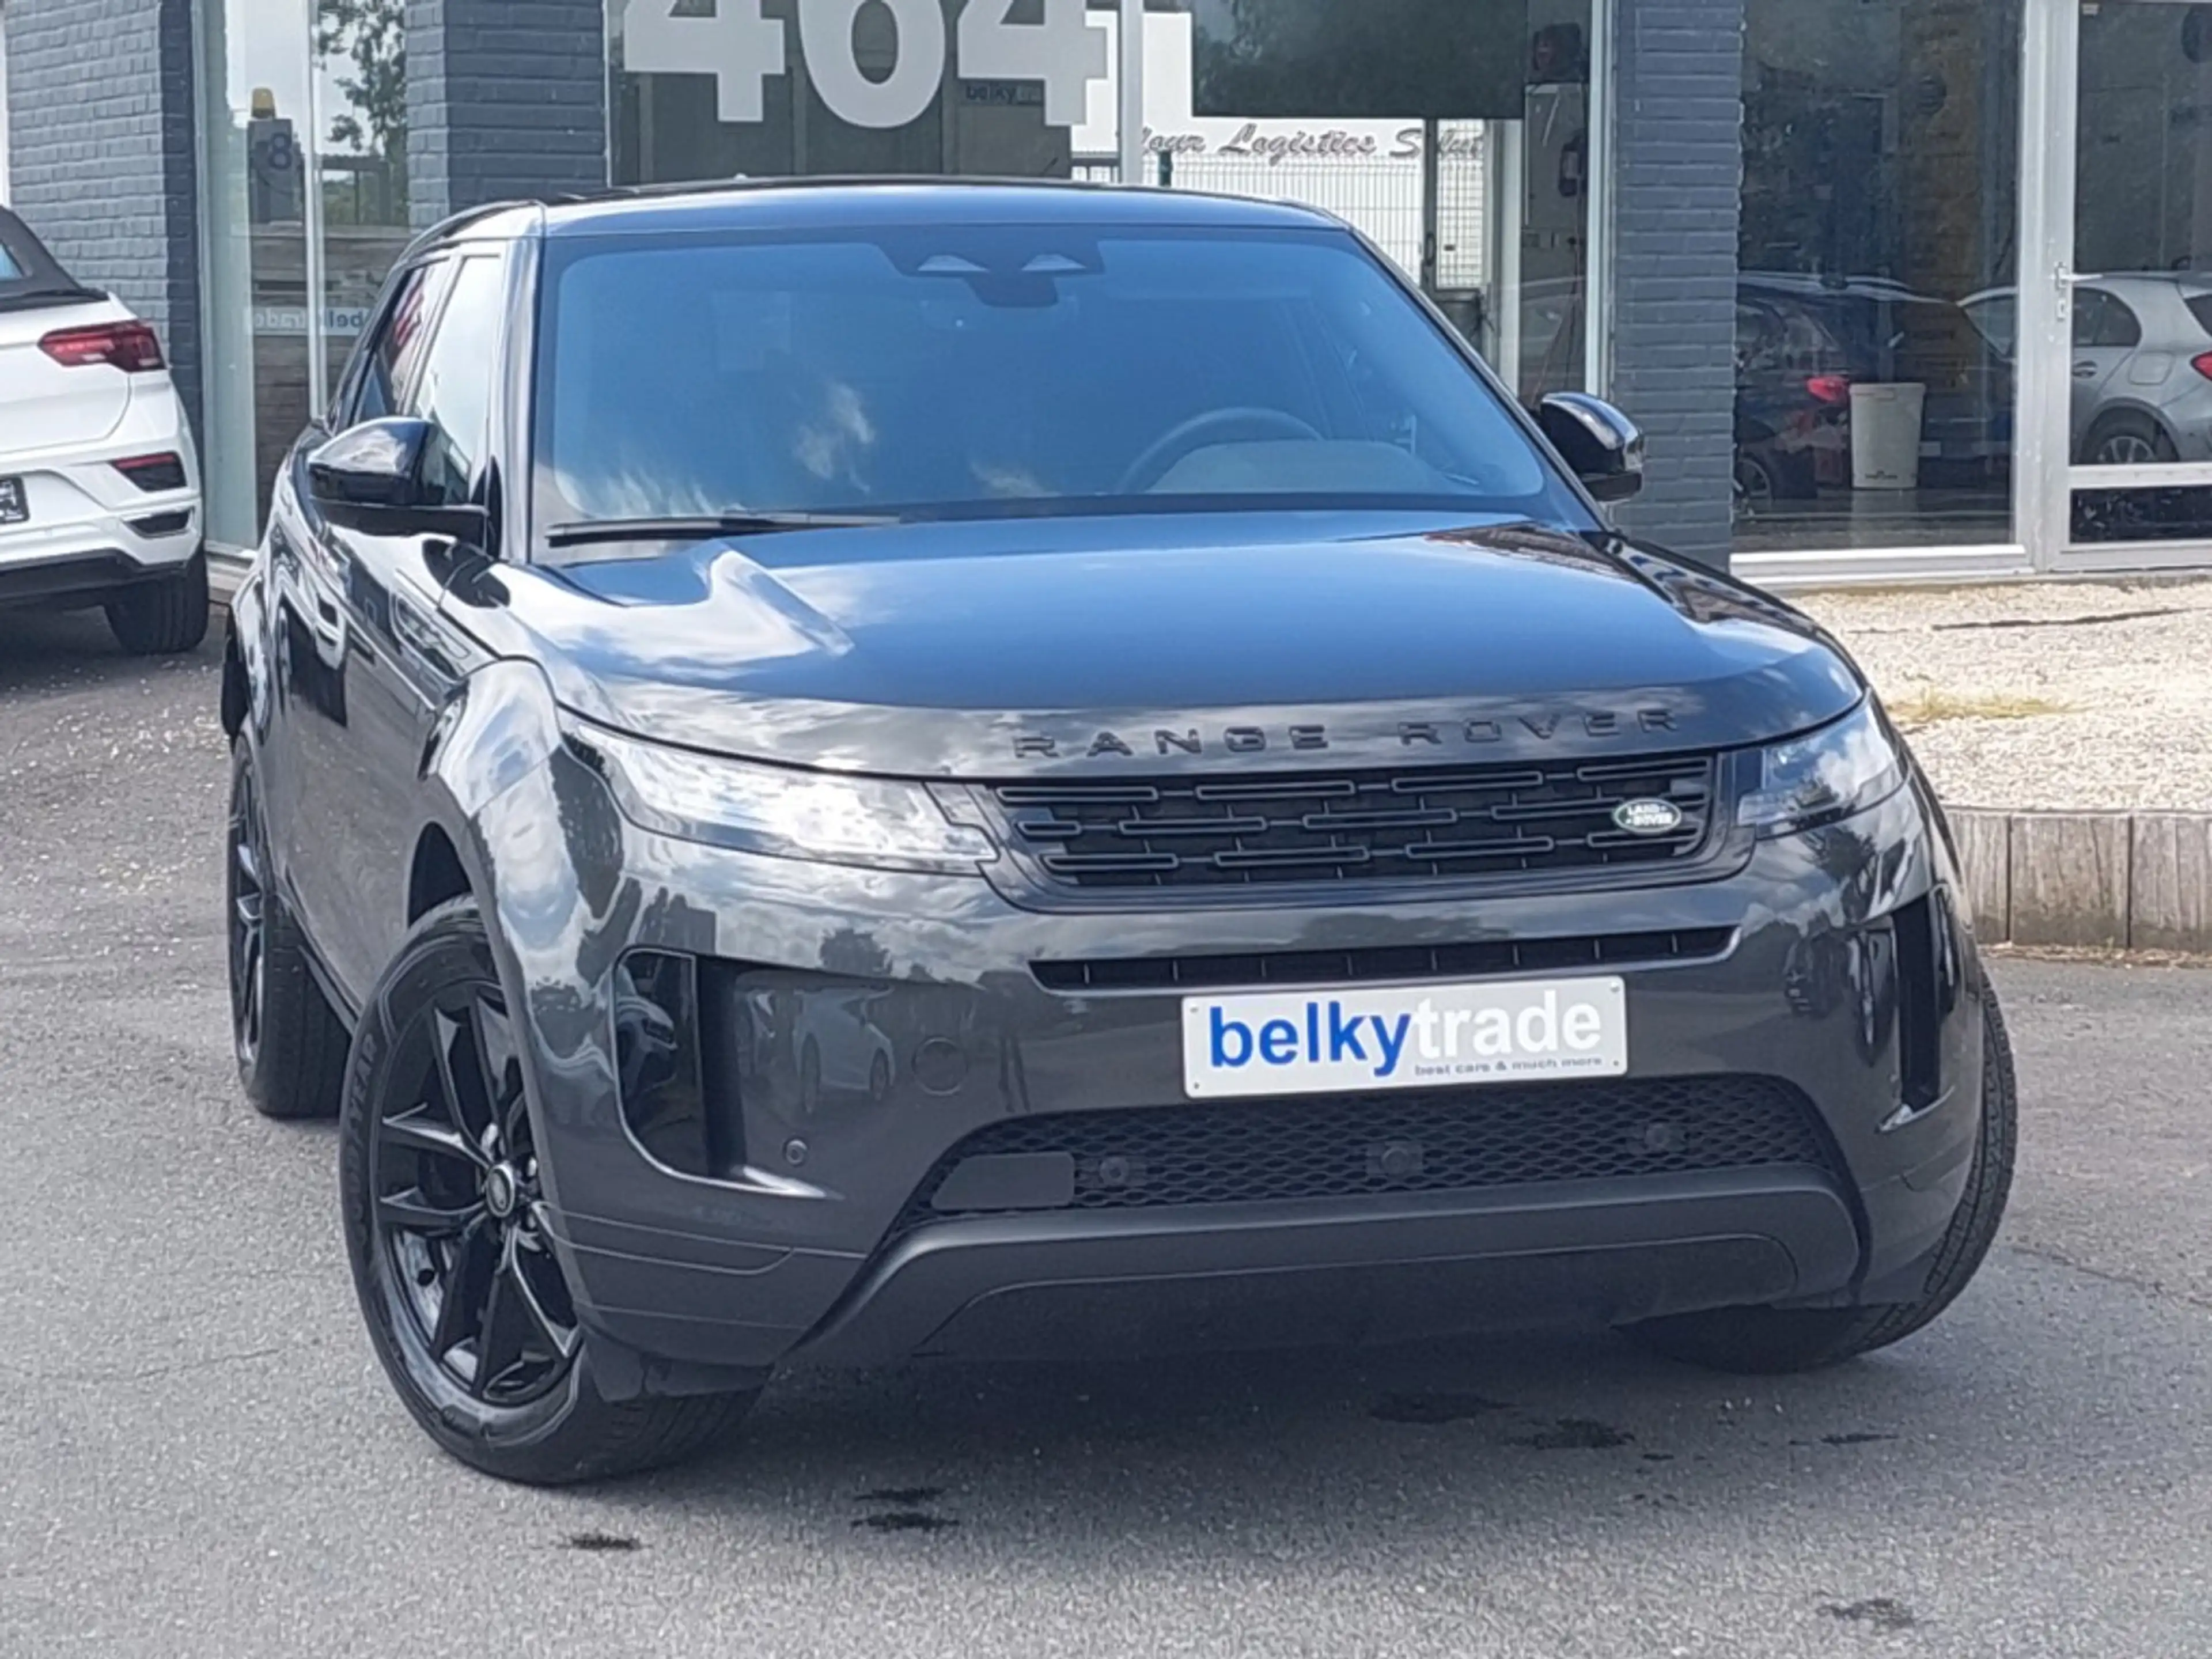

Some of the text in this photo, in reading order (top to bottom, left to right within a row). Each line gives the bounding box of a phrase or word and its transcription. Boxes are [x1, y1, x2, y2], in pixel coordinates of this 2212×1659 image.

[1218, 123, 1377, 167] Logistics
[1013, 708, 1679, 758] RANGE ROVER
[1209, 990, 1601, 1077] belkytrade
[1415, 1063, 1450, 1076] best
[1495, 1060, 1507, 1071] &
[1512, 1058, 1558, 1071] much
[1561, 1057, 1603, 1067] more
